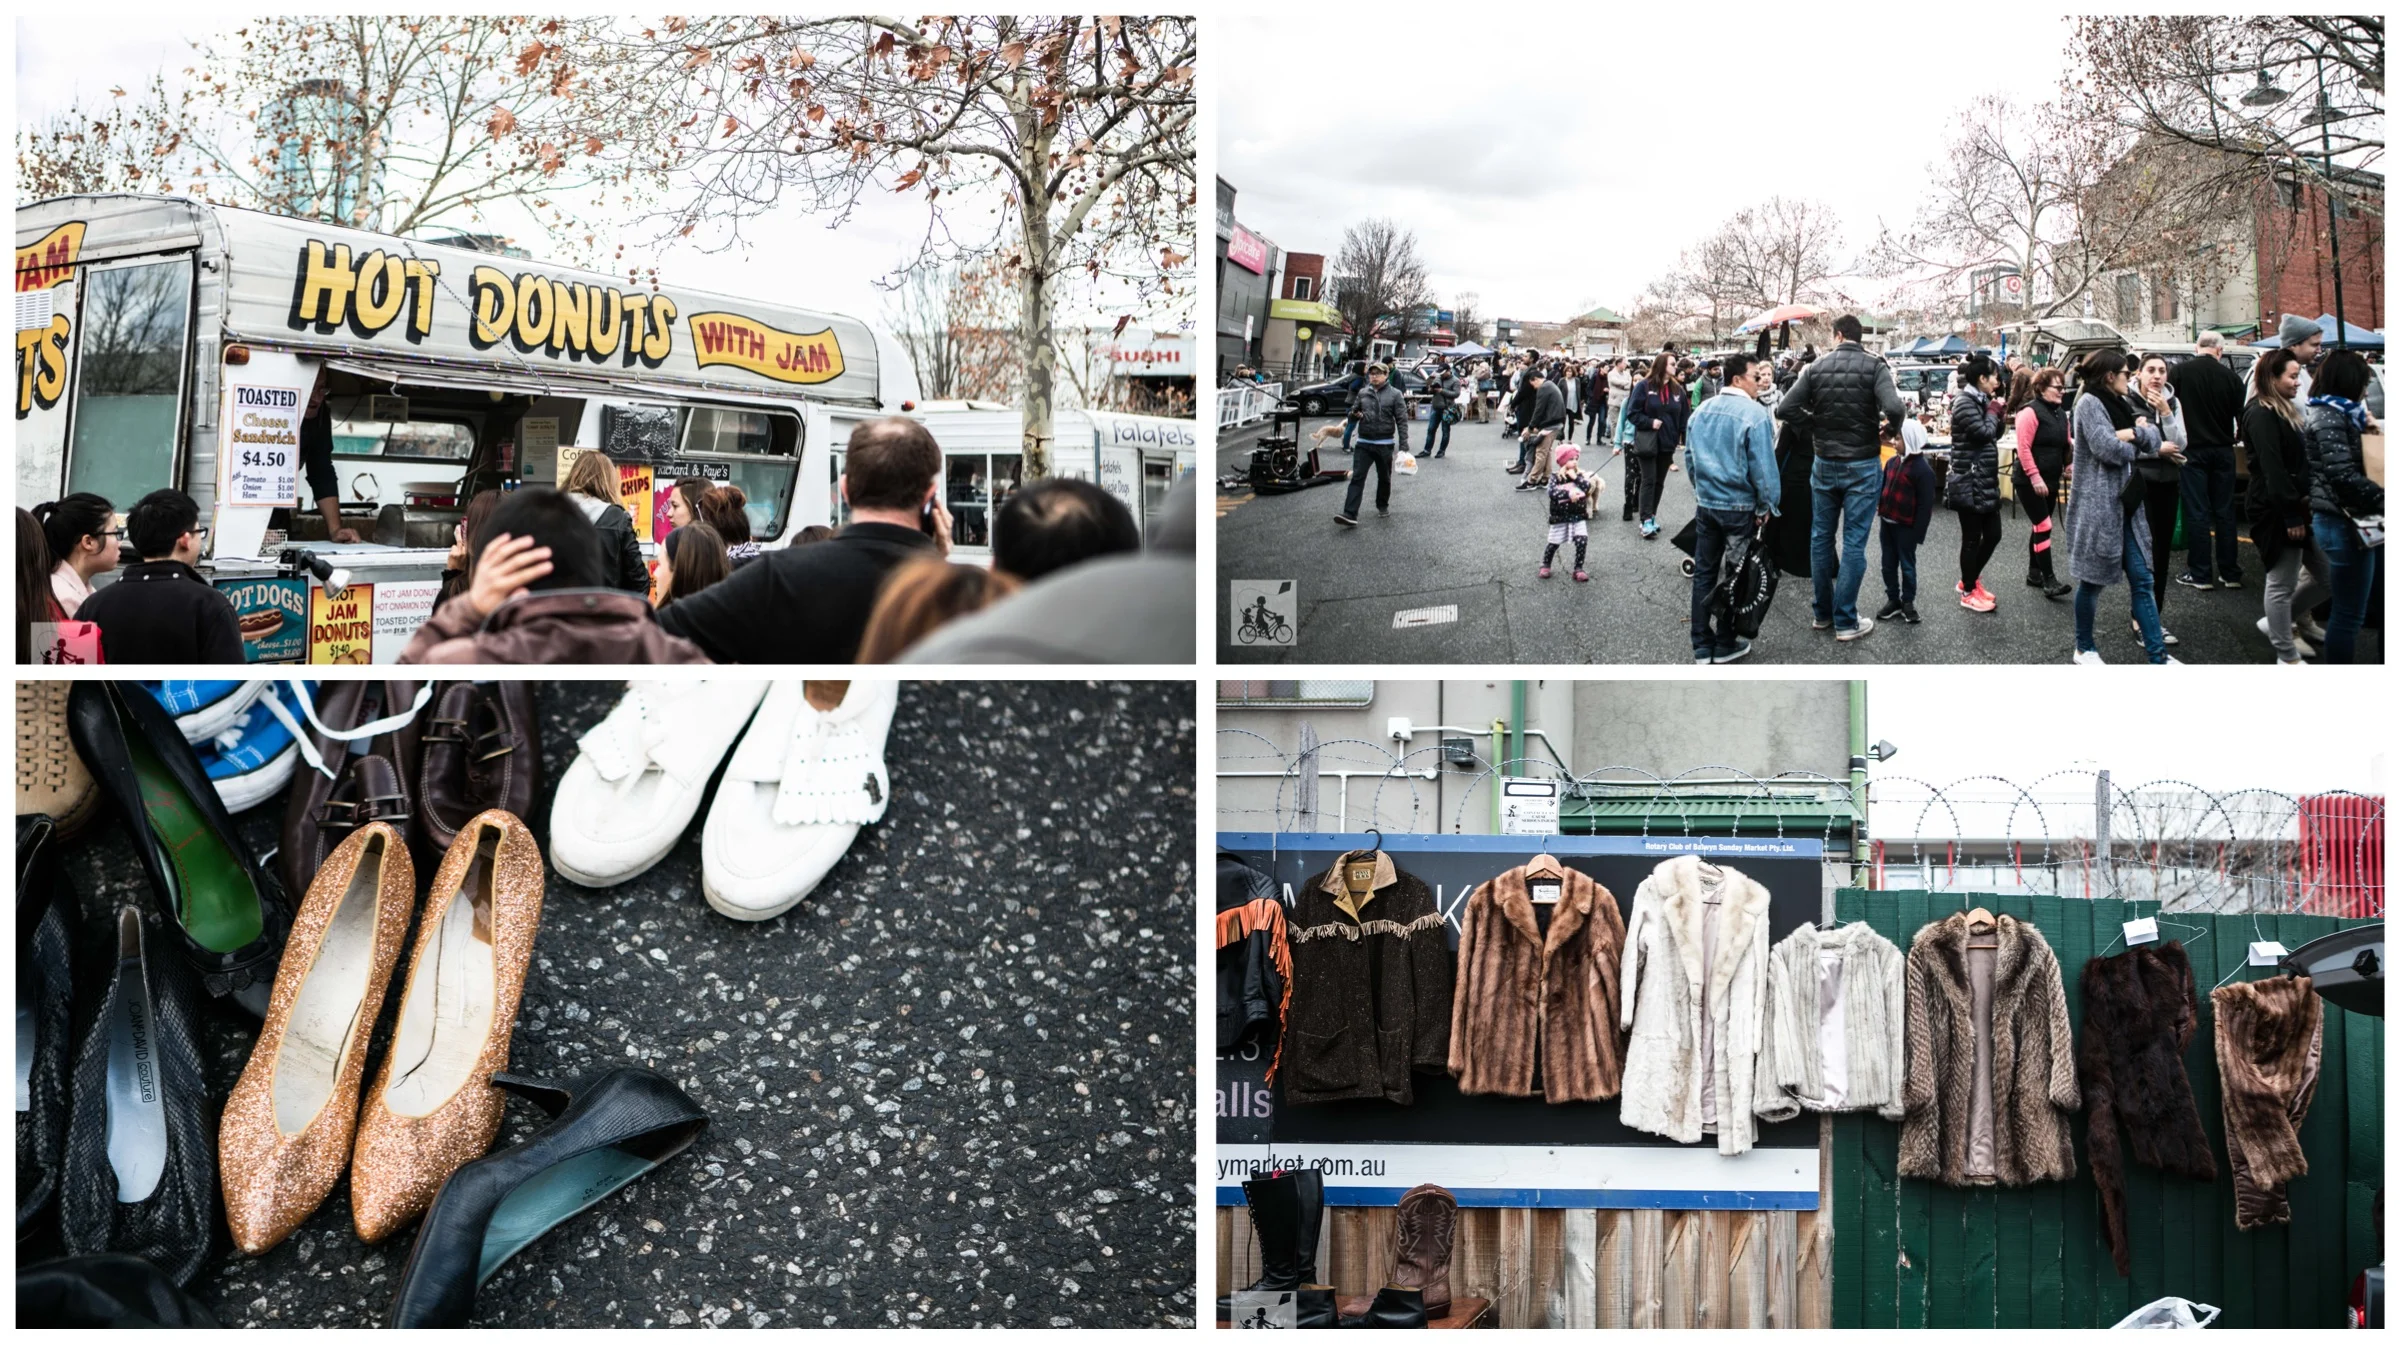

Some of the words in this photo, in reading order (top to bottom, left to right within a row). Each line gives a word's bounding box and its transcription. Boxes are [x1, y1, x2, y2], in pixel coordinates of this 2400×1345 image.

[288, 239, 441, 345] HOT
[469, 265, 677, 370] DONUTS
[699, 321, 765, 362] WITH
[776, 341, 832, 373] JAM
[1110, 350, 1181, 363] SUSHI
[237, 387, 297, 407] TOASTED
[242, 413, 289, 429] Cheese
[233, 429, 297, 445] Sandwich
[1113, 421, 1195, 448] falafels
[242, 450, 286, 467] $4.50
[242, 475, 267, 483] Tomato
[278, 476, 295, 484] $1.00
[692, 464, 700, 476] &
[703, 464, 728, 479] Faye's
[621, 476, 650, 497] CHIPS
[227, 586, 254, 611] OT
[256, 584, 304, 616] DOGS
[331, 588, 356, 602] OT
[380, 590, 395, 598] HOT
[397, 590, 412, 598] JAM
[326, 603, 358, 621] JAM
[375, 603, 388, 611] HOT
[389, 601, 420, 611] CINNAMON
[375, 616, 408, 626] TOASTED
[313, 621, 370, 644] DONUTS
[1645, 842, 1667, 851] Rotary
[1668, 842, 1683, 850] Club
[1693, 843, 1718, 852] Balwyn
[1718, 843, 1743, 852] Sunday
[1744, 843, 1768, 851] Market
[1769, 844, 1782, 853] Pty.
[127, 998, 143, 1029] JOAN
[132, 1031, 149, 1060] DAVID
[139, 1063, 153, 1100] couture
[1216, 1153, 1386, 1180] ymarketcom.au
